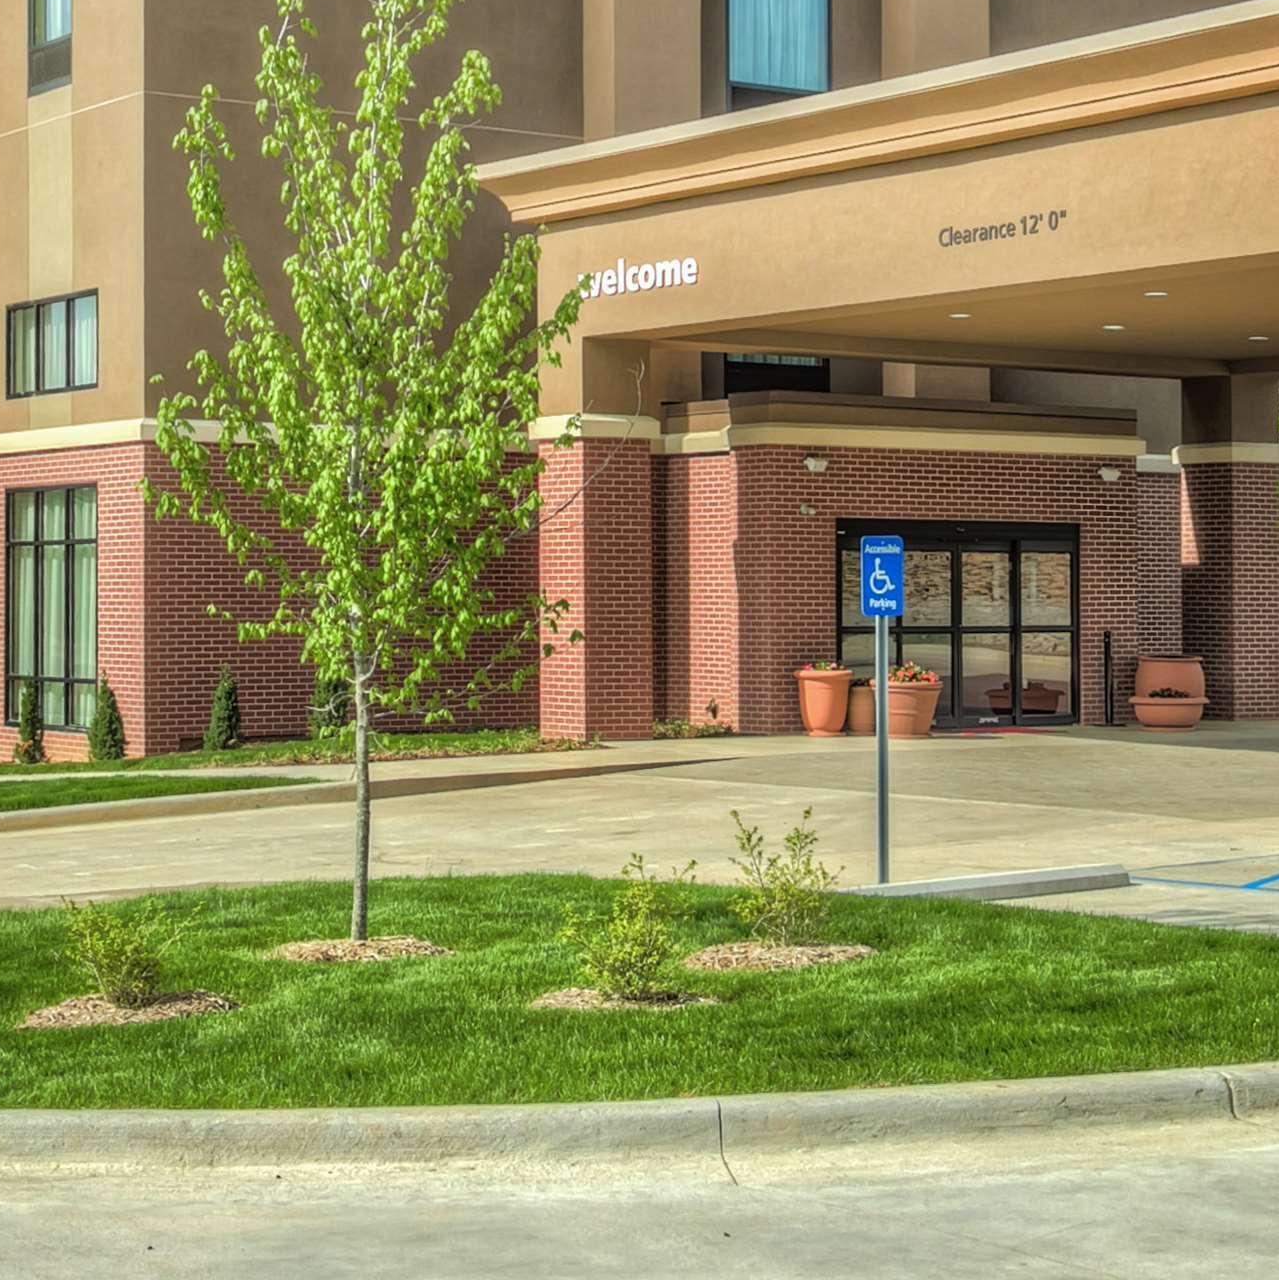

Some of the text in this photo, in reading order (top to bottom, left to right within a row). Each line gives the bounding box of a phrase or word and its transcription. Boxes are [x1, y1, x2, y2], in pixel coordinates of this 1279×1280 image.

[938, 222, 1017, 248] Clearance
[1020, 212, 1044, 236] 12'
[864, 543, 902, 555] Accessible
[869, 598, 897, 610] Parking
